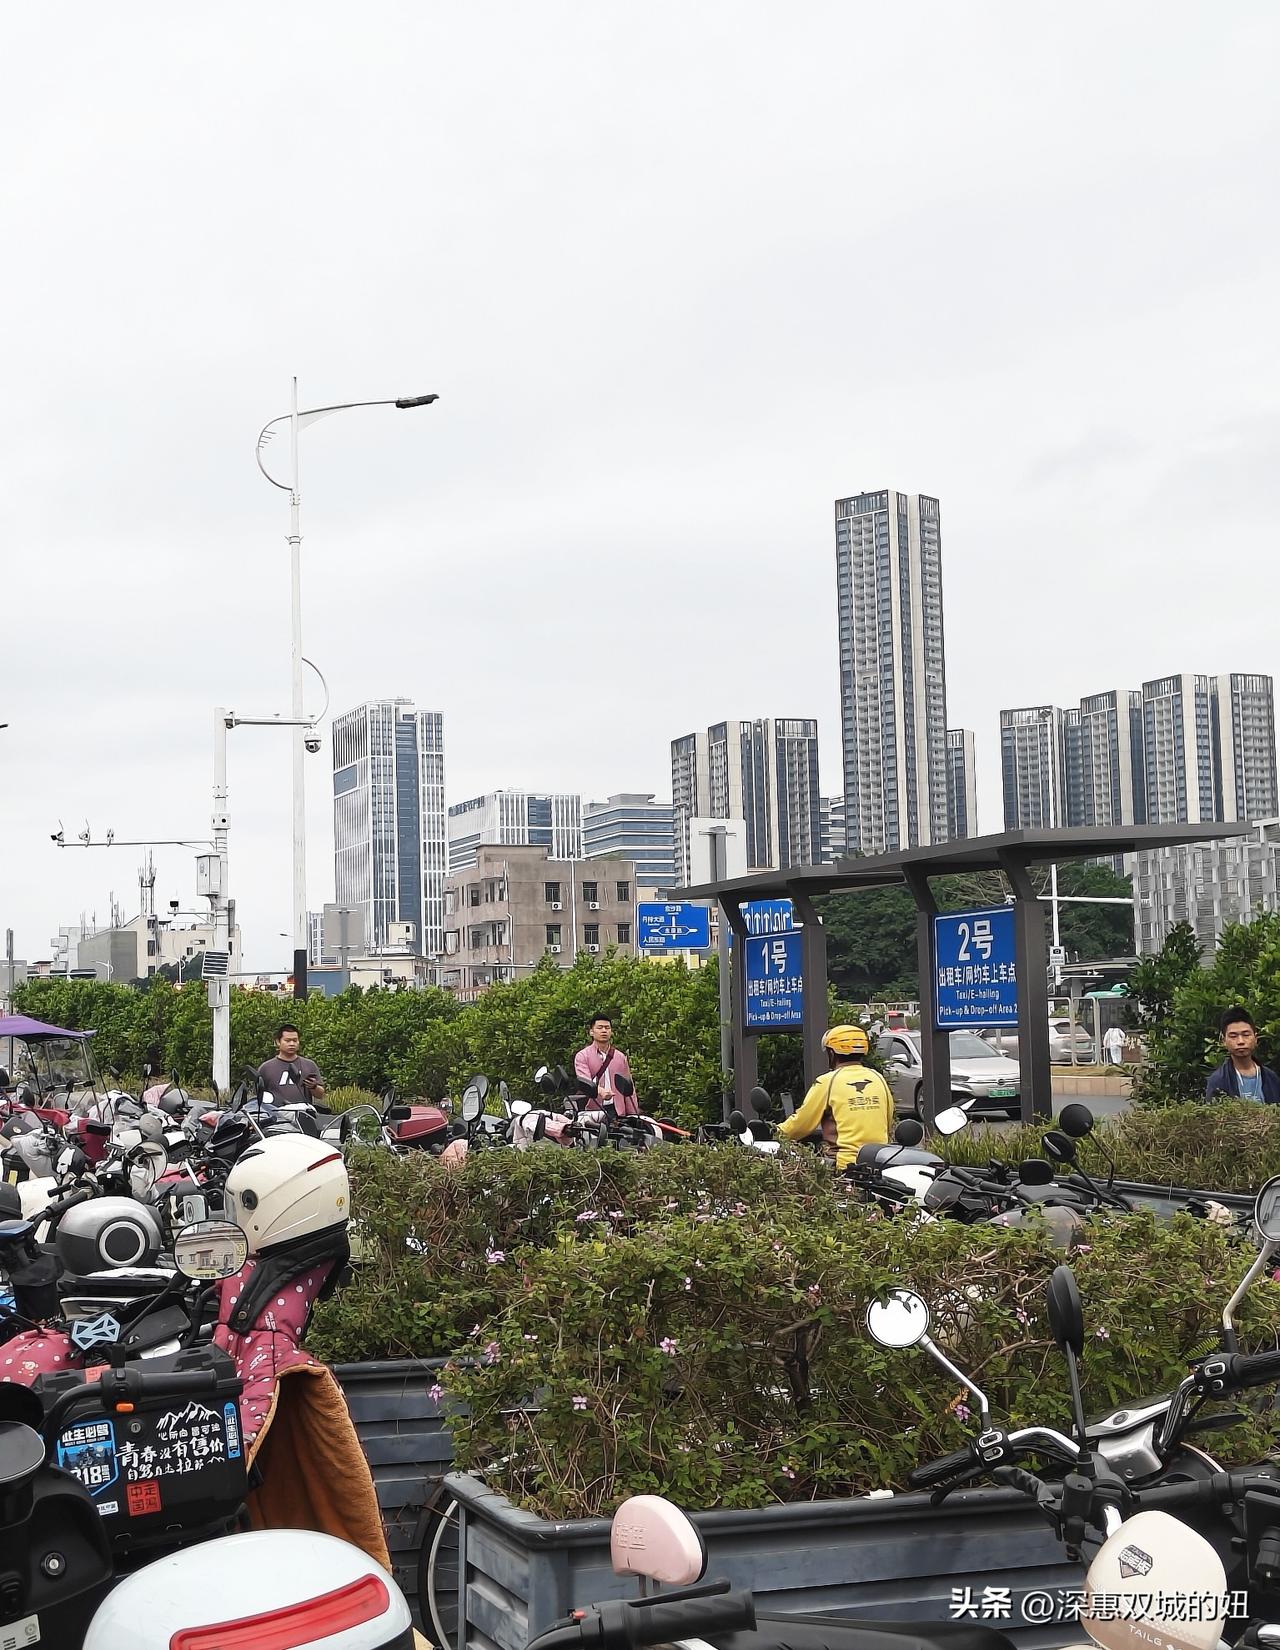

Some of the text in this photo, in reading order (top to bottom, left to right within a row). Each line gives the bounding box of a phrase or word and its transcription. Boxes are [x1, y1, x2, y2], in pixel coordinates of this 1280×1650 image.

[957, 920, 994, 961] 2号
[761, 940, 788, 975] 1号
[938, 962, 1017, 987] 出租车/网约车上车点
[956, 988, 1000, 1001] Taxi/E-hailing
[939, 1003, 1018, 1018] Pick-up & Drop-off Area 2
[115, 1436, 225, 1468] 青春没有售价
[1129, 1624, 1163, 1647] TAILG
